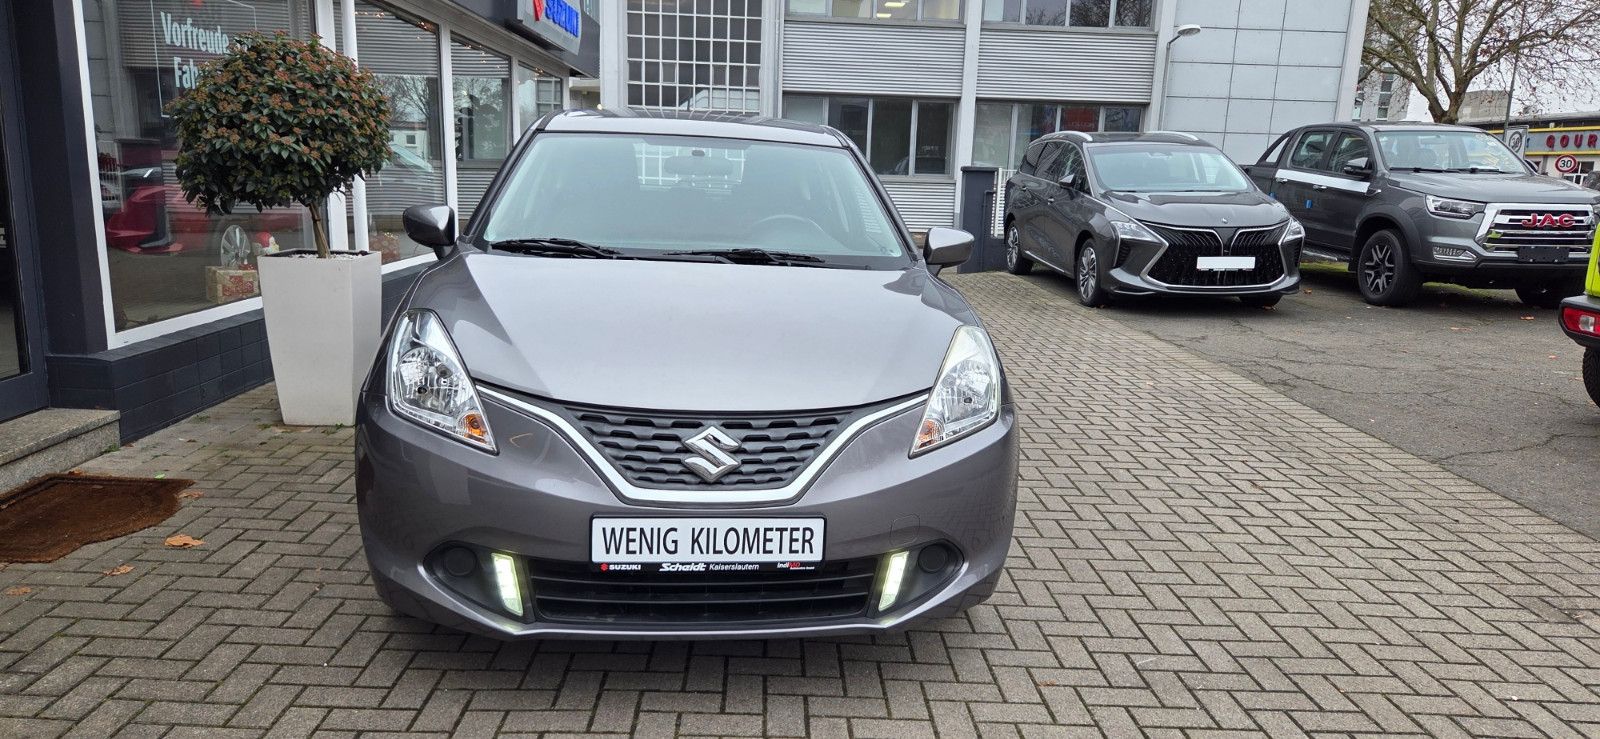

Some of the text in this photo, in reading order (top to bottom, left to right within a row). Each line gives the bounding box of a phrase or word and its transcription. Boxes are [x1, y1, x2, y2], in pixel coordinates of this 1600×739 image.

[160, 11, 230, 55] Vorfreude
[173, 56, 199, 90] Fah
[1559, 160, 1572, 168] 30
[1521, 213, 1575, 228] JAC
[602, 526, 815, 555] WENIG KILOMETER
[709, 563, 760, 571] Kaiserslautern
